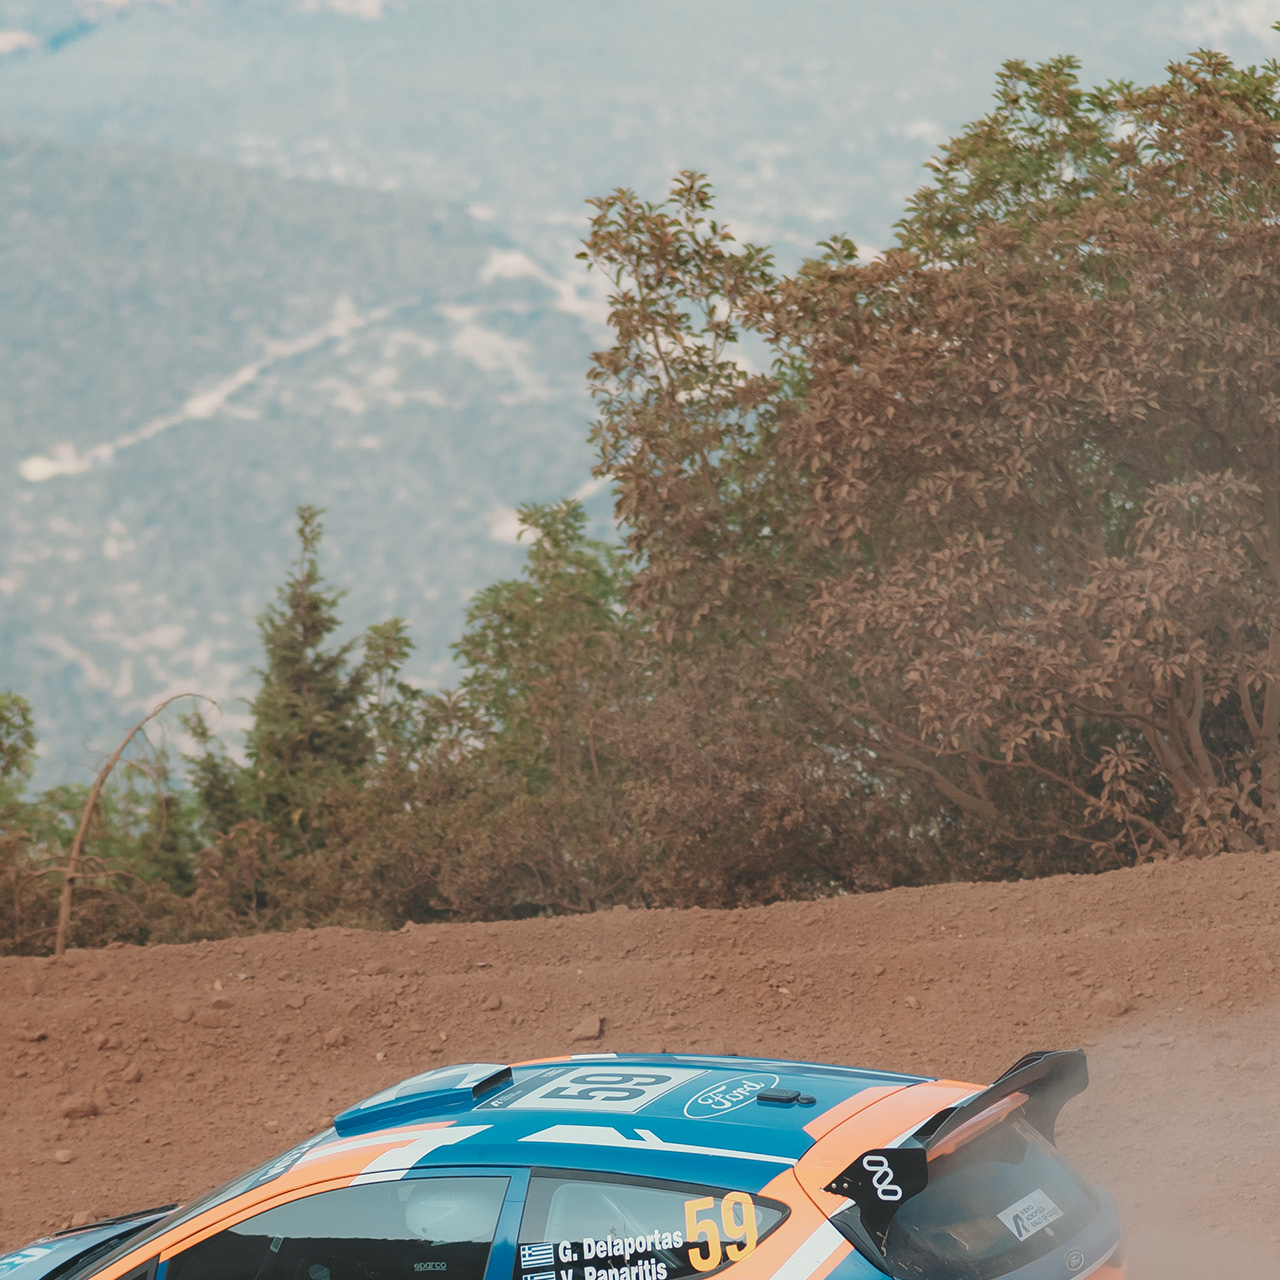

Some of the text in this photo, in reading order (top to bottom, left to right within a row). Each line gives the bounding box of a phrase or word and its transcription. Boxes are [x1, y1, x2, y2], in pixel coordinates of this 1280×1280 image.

[539, 1072, 672, 1102] 59
[697, 1079, 765, 1109] Ford
[558, 1229, 684, 1263] G. Delaportas
[684, 1191, 759, 1272] 59
